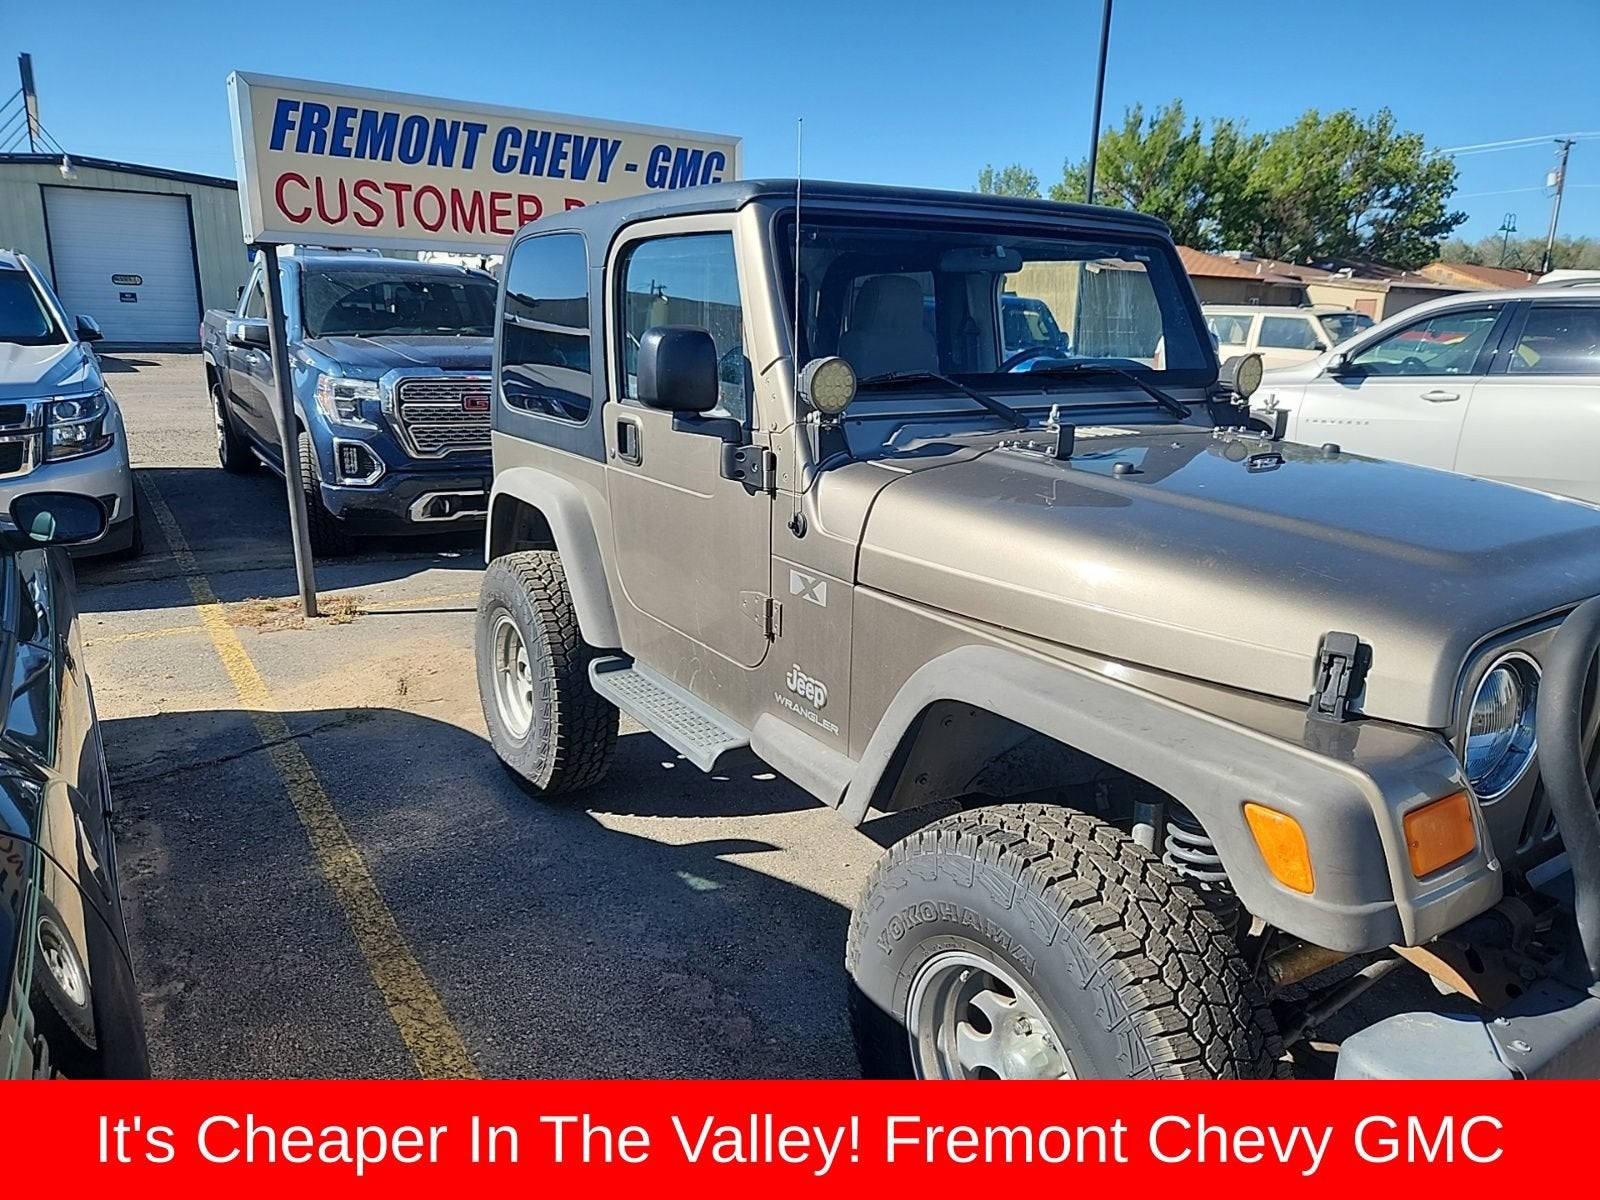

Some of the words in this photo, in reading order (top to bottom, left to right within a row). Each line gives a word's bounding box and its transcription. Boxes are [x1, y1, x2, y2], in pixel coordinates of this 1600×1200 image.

[269, 98, 488, 170] FREMONT
[492, 126, 622, 183] CHEVY
[645, 144, 726, 190] GMC
[774, 692, 840, 736] WRANGLER
[786, 664, 828, 710] Jeep
[877, 899, 1037, 977] YOKOHAMA
